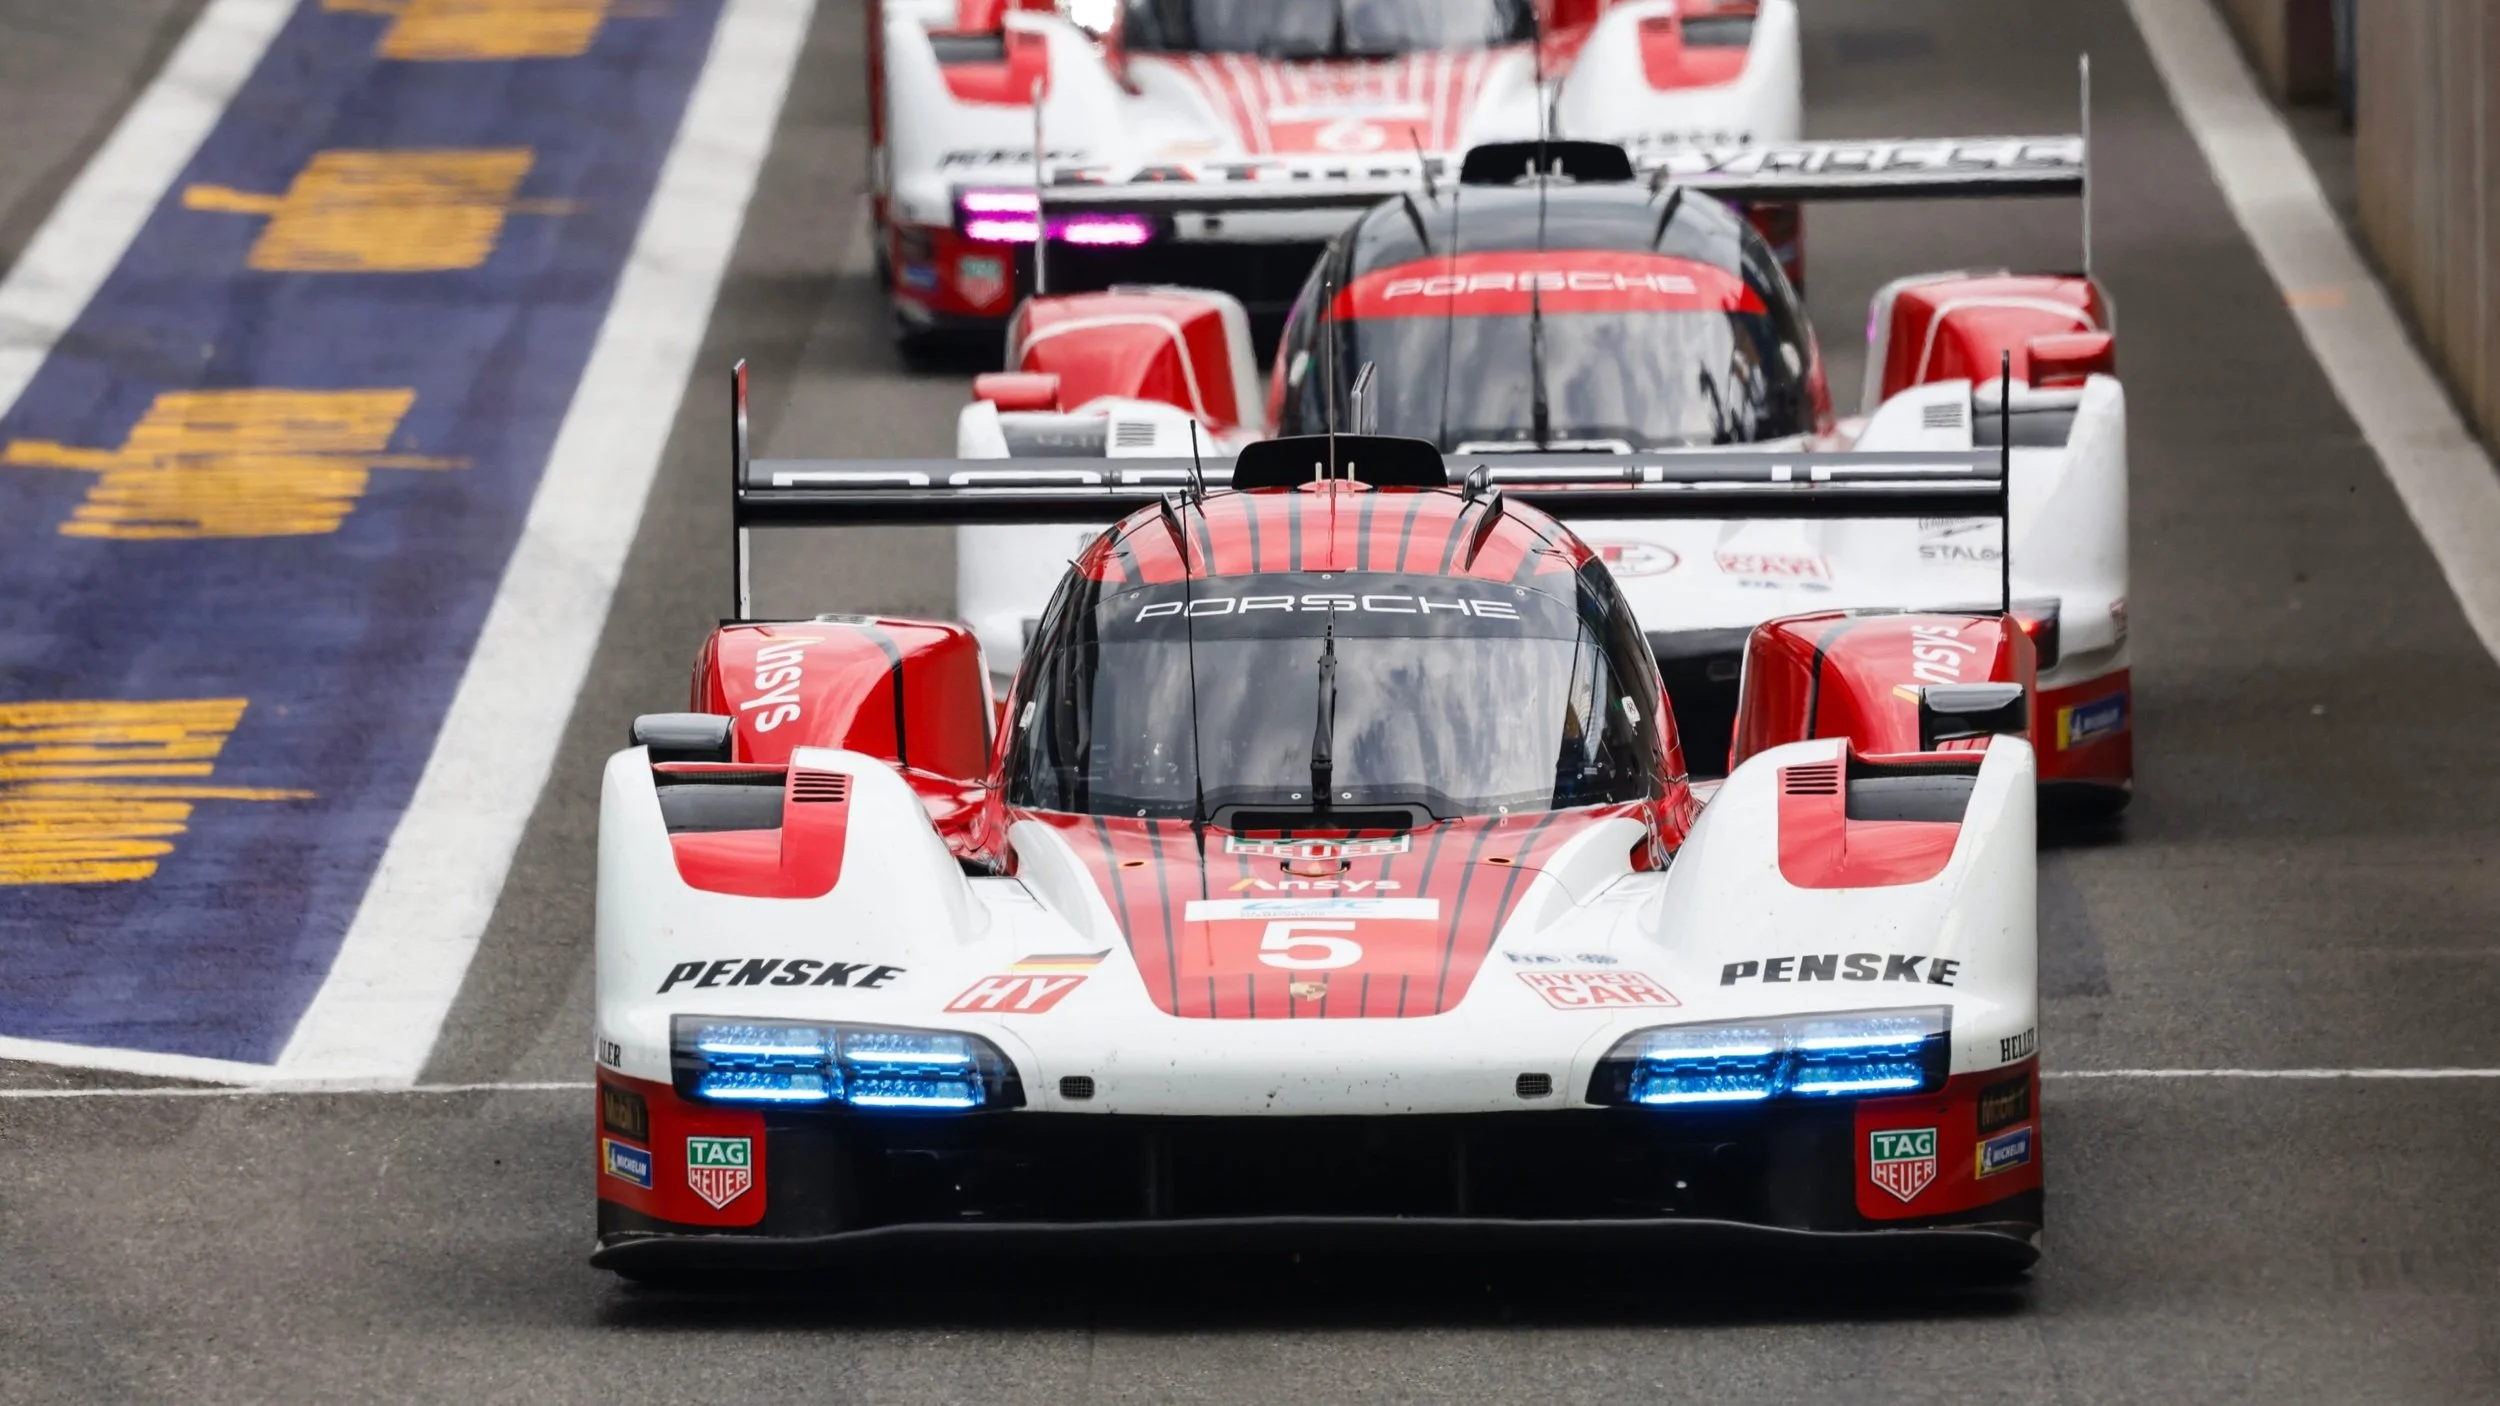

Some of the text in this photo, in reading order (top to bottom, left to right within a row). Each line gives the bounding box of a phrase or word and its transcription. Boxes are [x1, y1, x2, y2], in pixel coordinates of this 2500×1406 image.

[1383, 270, 1697, 301] PORSCHE
[1135, 594, 1520, 623] PORSCHE
[740, 636, 825, 733] Ansys
[1228, 878, 1402, 893] Ansys
[1257, 921, 1363, 970] 5
[656, 958, 907, 995] PENSKE
[1529, 973, 1645, 986] HYPER
[1720, 953, 1960, 987] PENSKE
[967, 977, 1070, 1010] HY
[1546, 985, 1669, 1005] CAR
[691, 1142, 745, 1164] TAG
[1876, 1134, 1932, 1157] TAG
[691, 1169, 748, 1203] HEUER
[1876, 1161, 1933, 1196] HEUER
